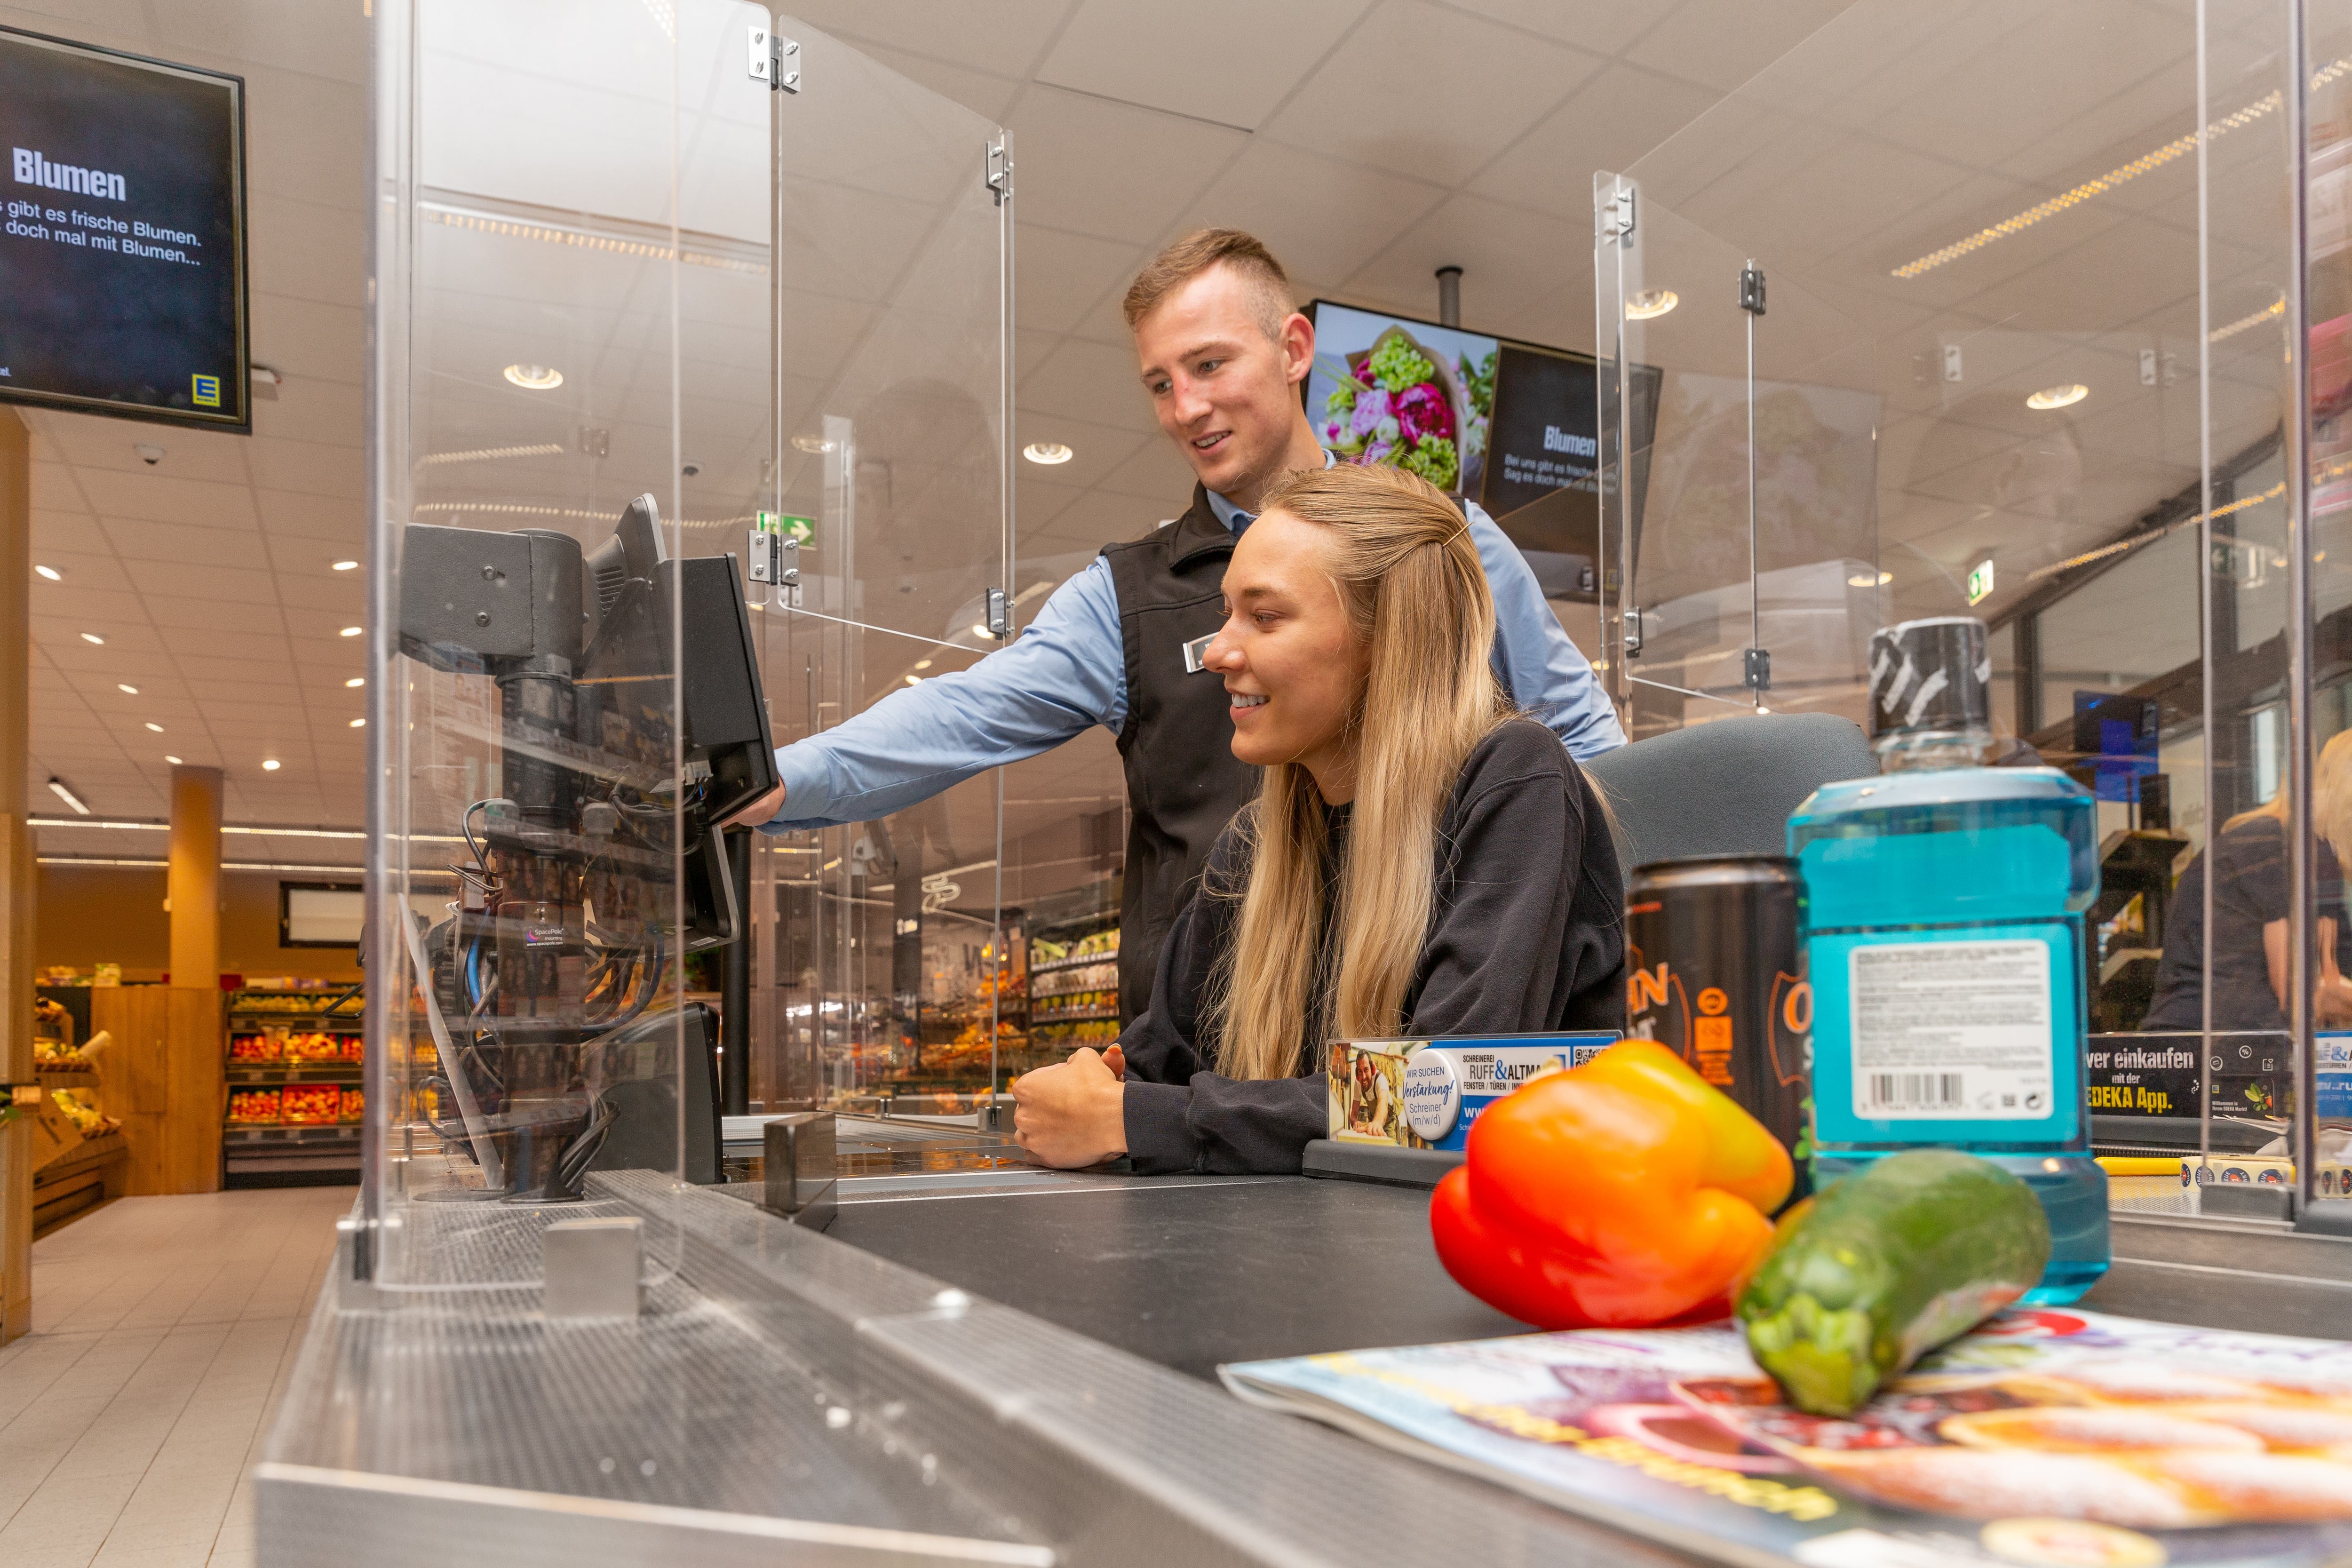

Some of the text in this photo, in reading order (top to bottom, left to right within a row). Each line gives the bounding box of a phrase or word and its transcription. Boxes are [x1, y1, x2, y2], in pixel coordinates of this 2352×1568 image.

[13, 147, 126, 201] Blumen
[8, 200, 40, 218] gibt
[46, 208, 67, 223] es
[71, 210, 128, 233] frische
[134, 221, 202, 247] Blumen.
[6, 220, 48, 239] doch
[55, 230, 87, 246] mal
[91, 236, 118, 252] mit
[122, 239, 200, 266] Blumen...
[1543, 425, 1597, 458] Blumen
[2086, 1047, 2194, 1069] ver einkaufen
[1407, 1067, 1445, 1078] WIR SUCHEN
[2112, 1073, 2140, 1084] mit der
[1402, 1079, 1455, 1106] Verstärkung!
[1490, 1080, 1506, 1090] TÜREN
[1409, 1102, 1442, 1114] Schreiner
[2086, 1086, 2173, 1114] EDEKA App.
[1412, 1113, 1440, 1128] (m/w/d)
